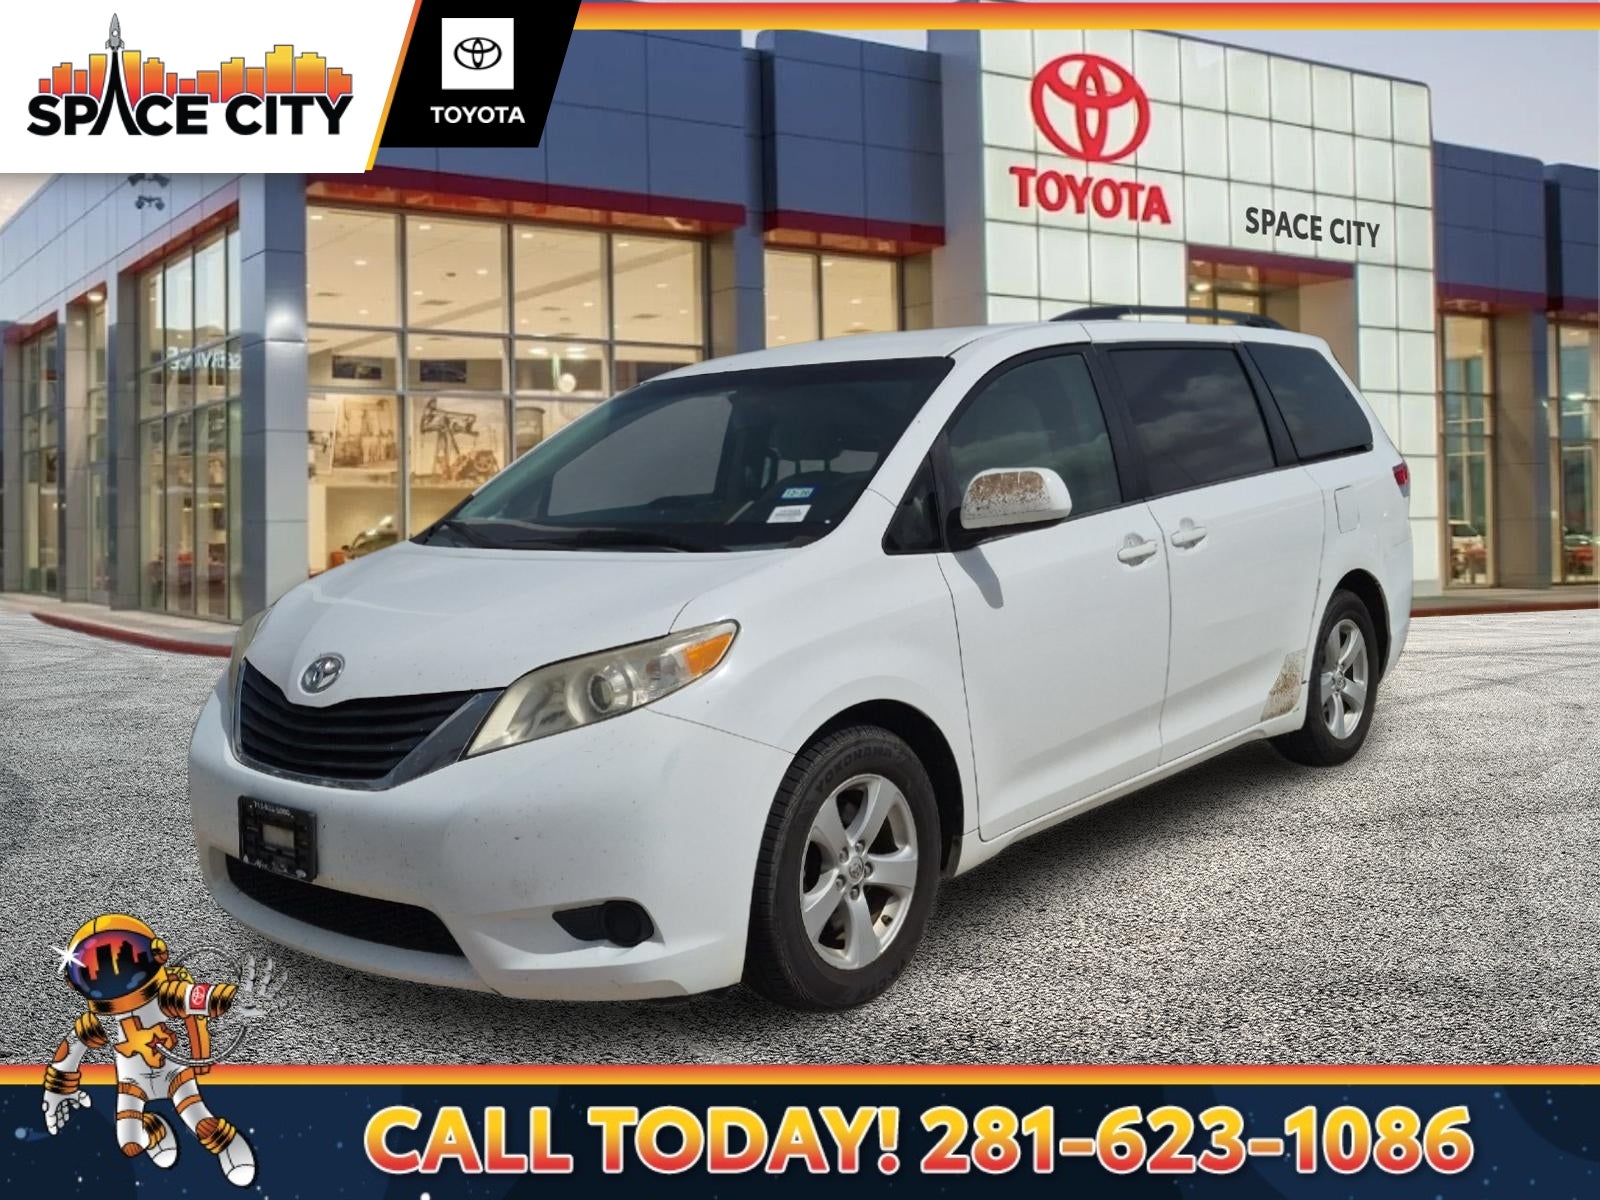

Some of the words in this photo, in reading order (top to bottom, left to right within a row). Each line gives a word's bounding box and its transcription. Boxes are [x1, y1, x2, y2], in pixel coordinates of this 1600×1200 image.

[1009, 166, 1172, 225] TOYOTA
[1245, 206, 1322, 242] SPACE
[1329, 217, 1381, 248] CITY
[815, 745, 892, 792] YOKOHAMA
